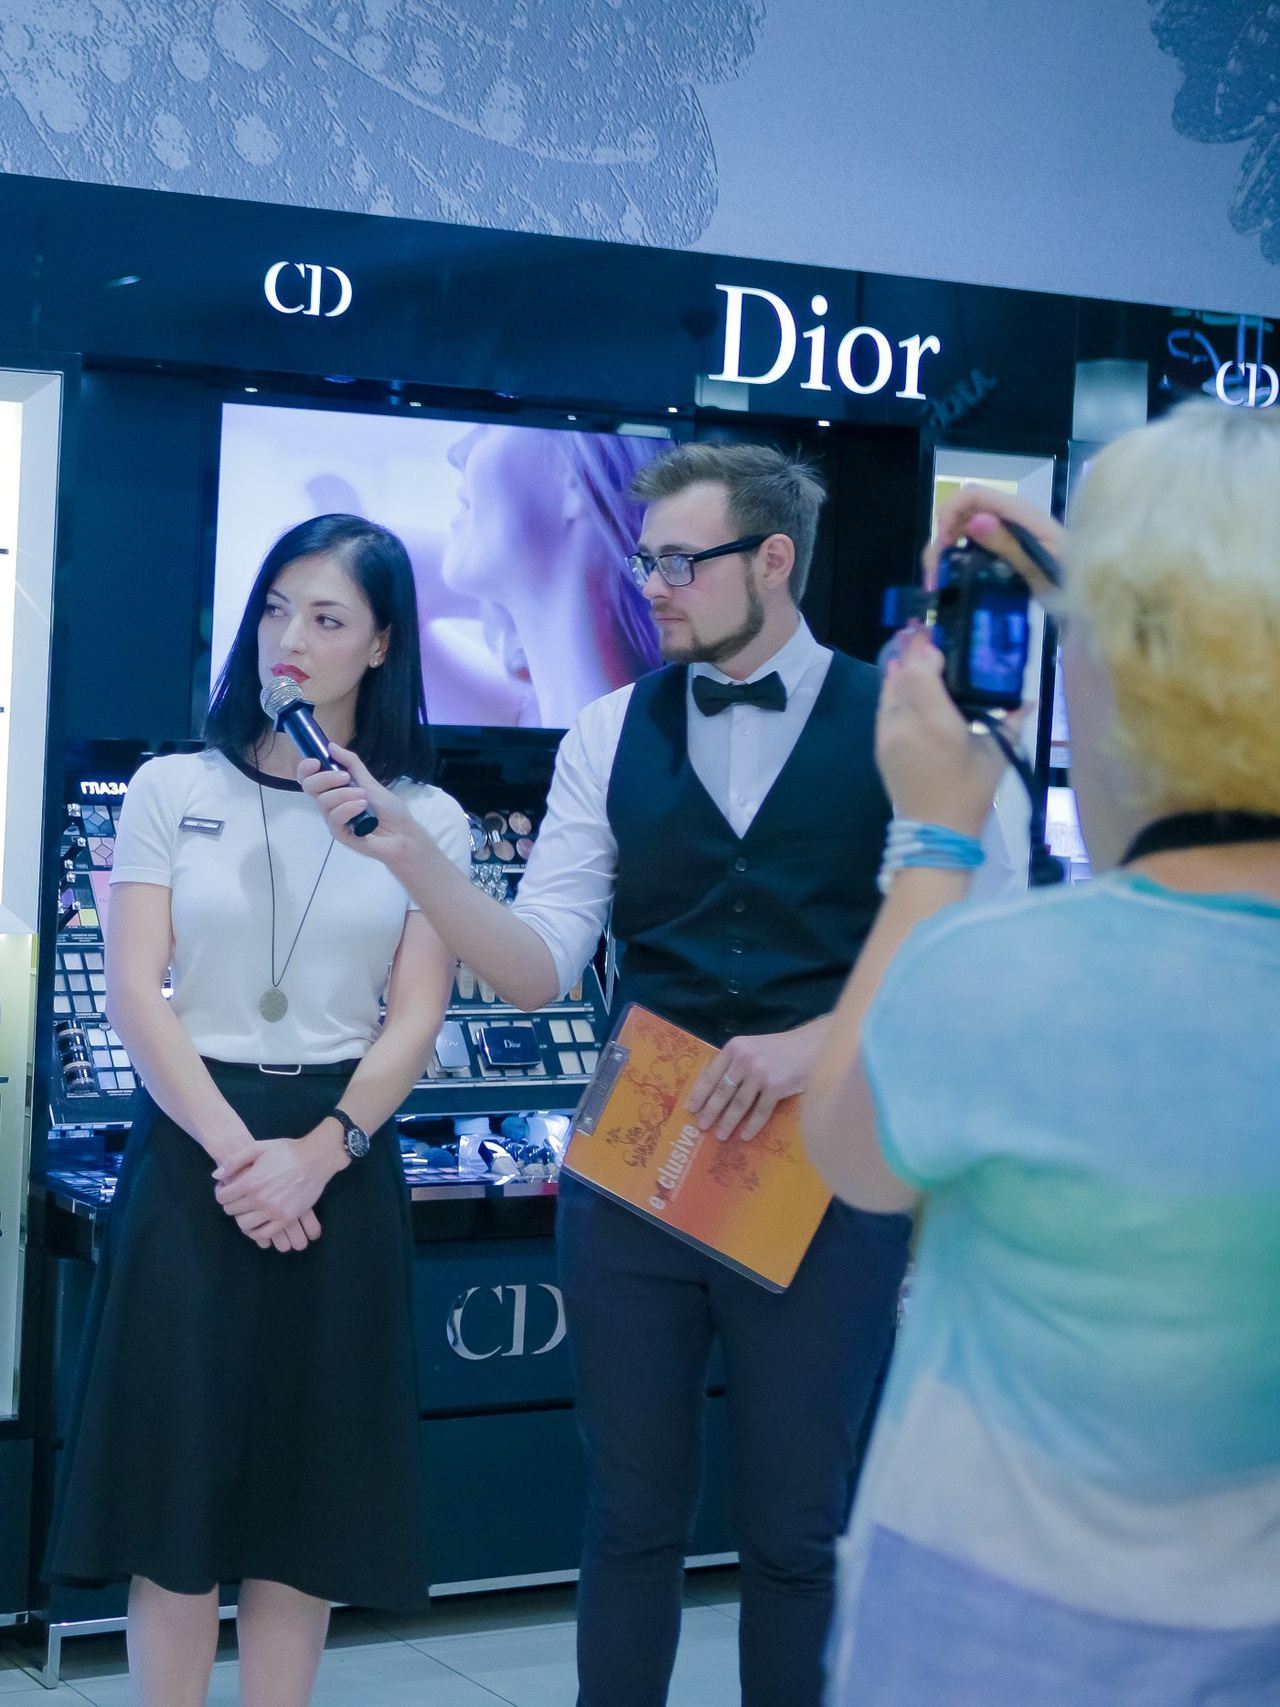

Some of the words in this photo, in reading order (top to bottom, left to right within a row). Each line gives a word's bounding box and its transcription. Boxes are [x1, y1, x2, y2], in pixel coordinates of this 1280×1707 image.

[708, 284, 941, 400] Dior
[80, 781, 128, 795] ГЛАЗА
[503, 1040, 521, 1049] Dior
